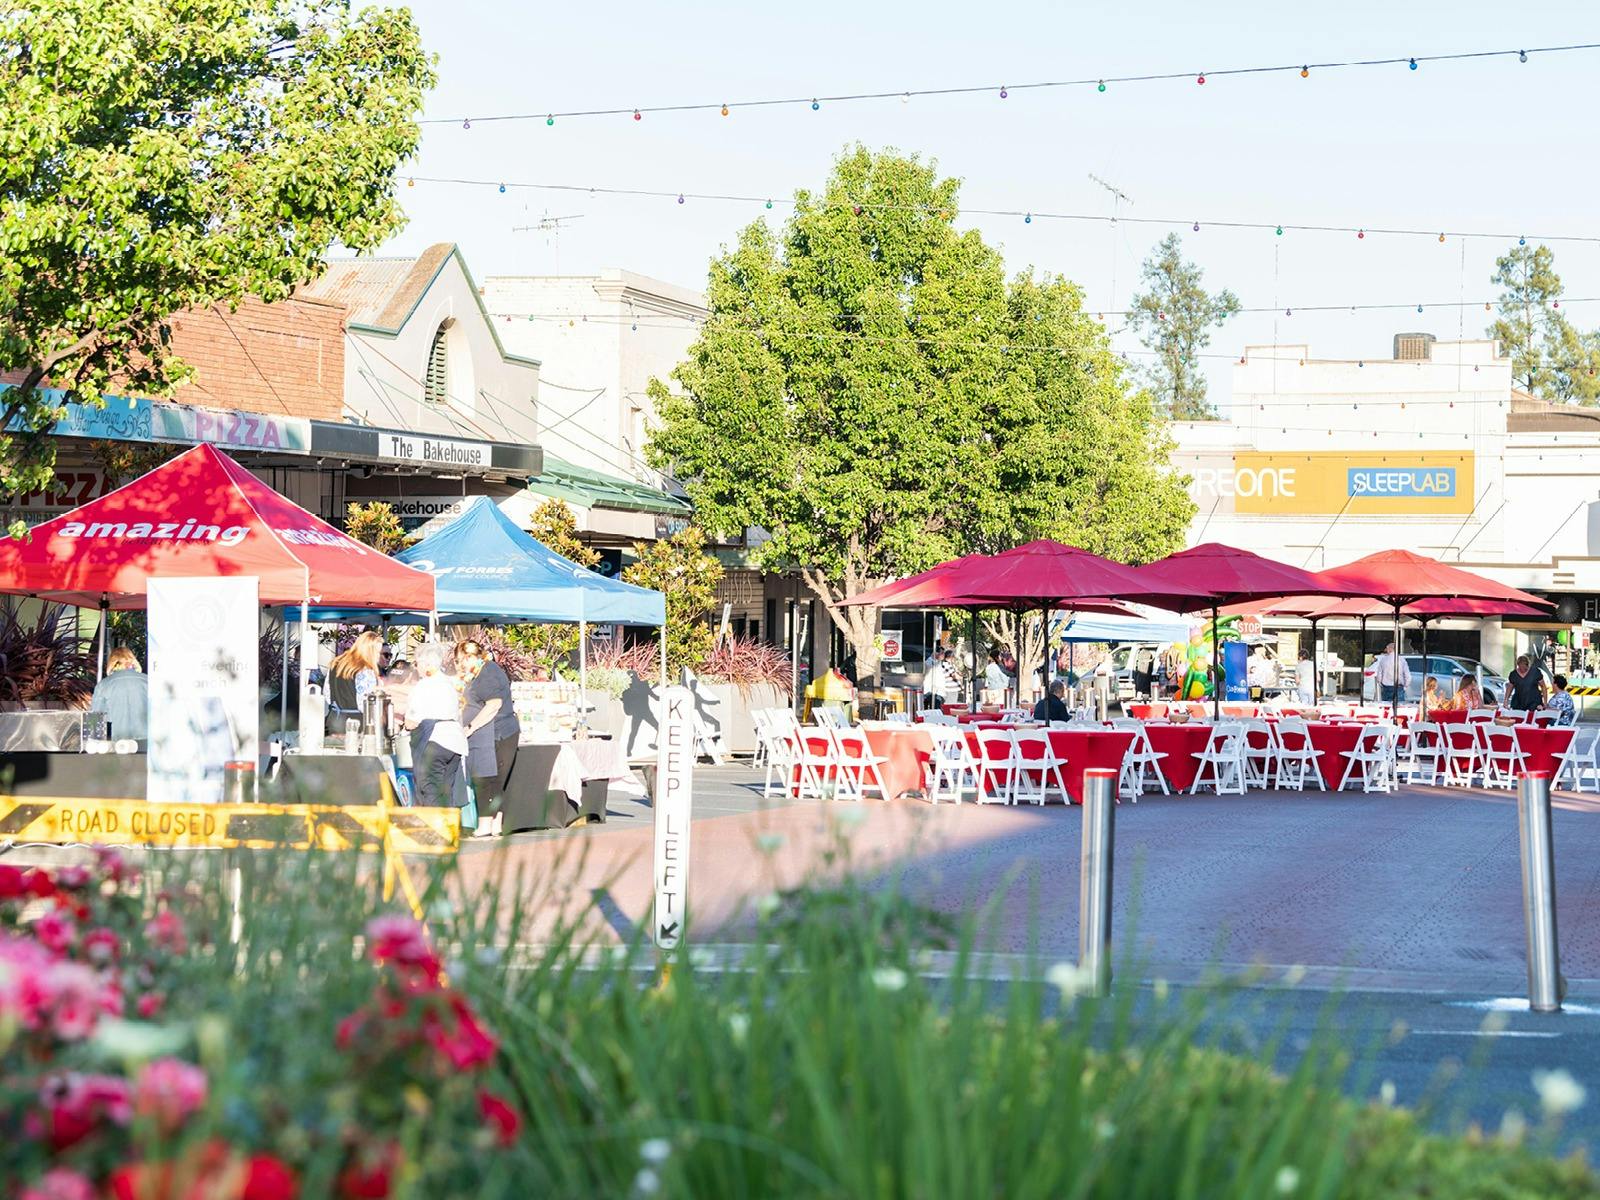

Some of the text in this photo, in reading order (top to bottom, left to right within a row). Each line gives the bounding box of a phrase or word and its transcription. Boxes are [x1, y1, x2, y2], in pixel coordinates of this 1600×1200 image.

[195, 411, 282, 448] PIZZA
[391, 436, 482, 464] The Bakehouse
[1353, 472, 1450, 492] SLEEPLAB
[379, 500, 461, 515] akehouse
[58, 518, 251, 547] amazing
[1238, 622, 1261, 633] STOP
[663, 699, 683, 914] KEEP LEFT
[61, 809, 215, 836] ROAD CLOSED
